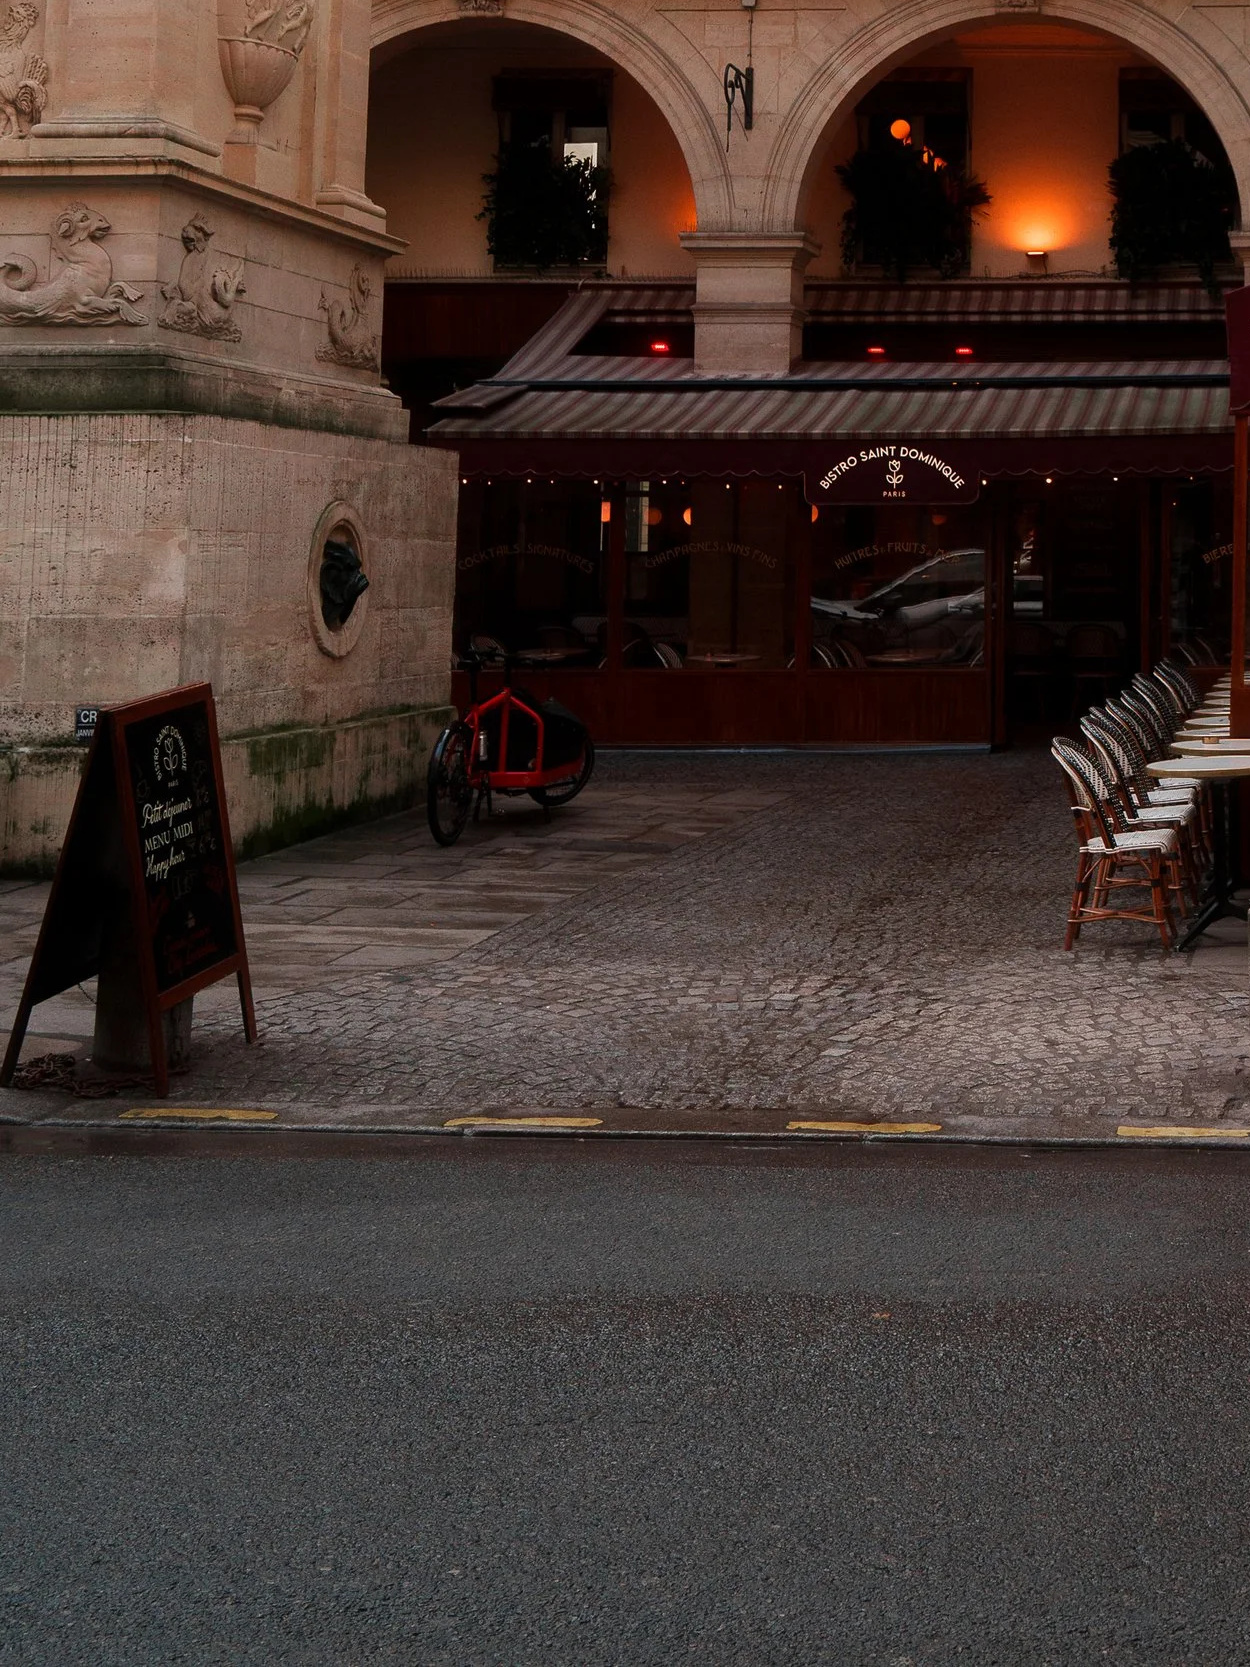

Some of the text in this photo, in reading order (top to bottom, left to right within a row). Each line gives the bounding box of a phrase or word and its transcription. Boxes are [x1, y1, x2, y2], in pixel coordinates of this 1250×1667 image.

[819, 445, 965, 490] BISTRO SAINT DOMINIQUE
[882, 490, 906, 498] PARIS
[457, 542, 596, 575] COCKTAILS SIGNATURES
[644, 540, 719, 568] CHAMPAGNES
[726, 541, 751, 557] VINS
[751, 548, 778, 569] FINS
[833, 544, 880, 570] HUITRES
[887, 541, 928, 555] FRUITS
[153, 725, 188, 781] BISTRO SAINT DOMINIQUE
[141, 800, 164, 829] Petit
[163, 797, 192, 827] déjeuner
[144, 821, 194, 854] MENU MIDI
[145, 846, 186, 882] Happy hour
